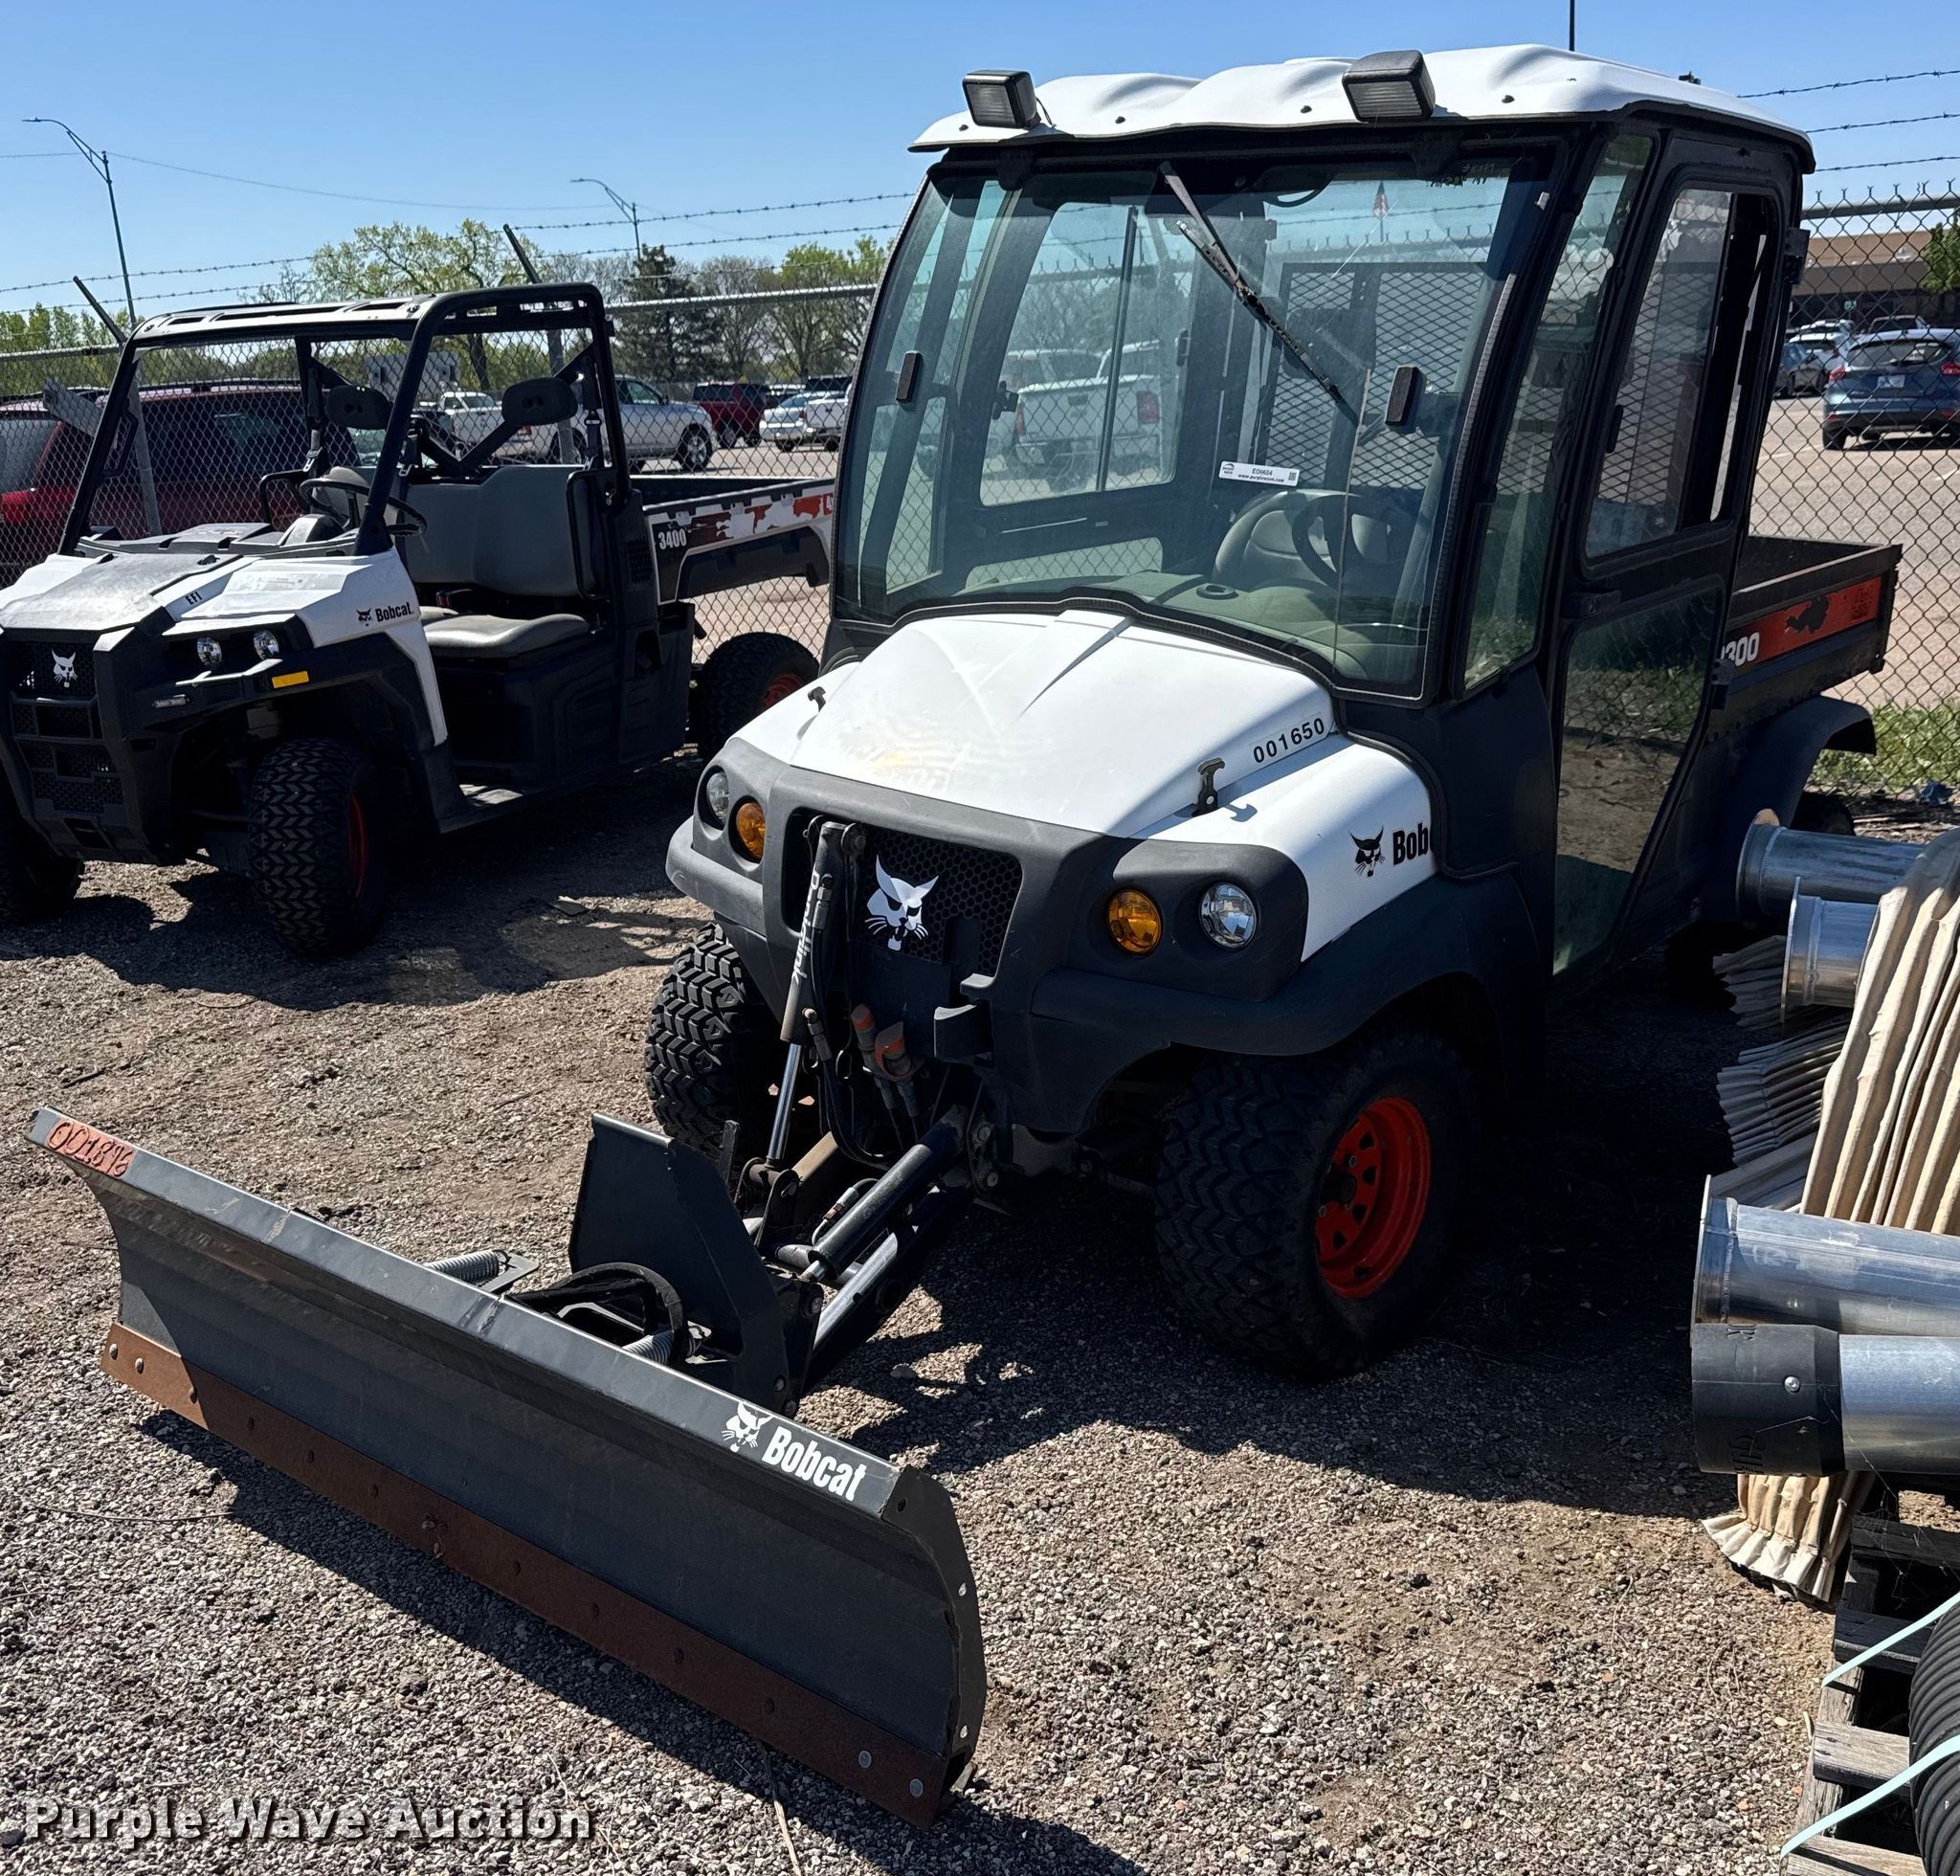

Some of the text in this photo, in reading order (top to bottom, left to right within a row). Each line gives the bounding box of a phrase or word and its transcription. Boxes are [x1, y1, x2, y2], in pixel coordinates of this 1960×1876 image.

[657, 527, 687, 550] 3400
[185, 592, 203, 605] EFI
[375, 601, 412, 622] Bobcat
[1721, 631, 1761, 667] 300
[1253, 717, 1325, 764] 001650
[1392, 821, 1430, 866] Bob
[761, 1425, 868, 1502] Bobcat
